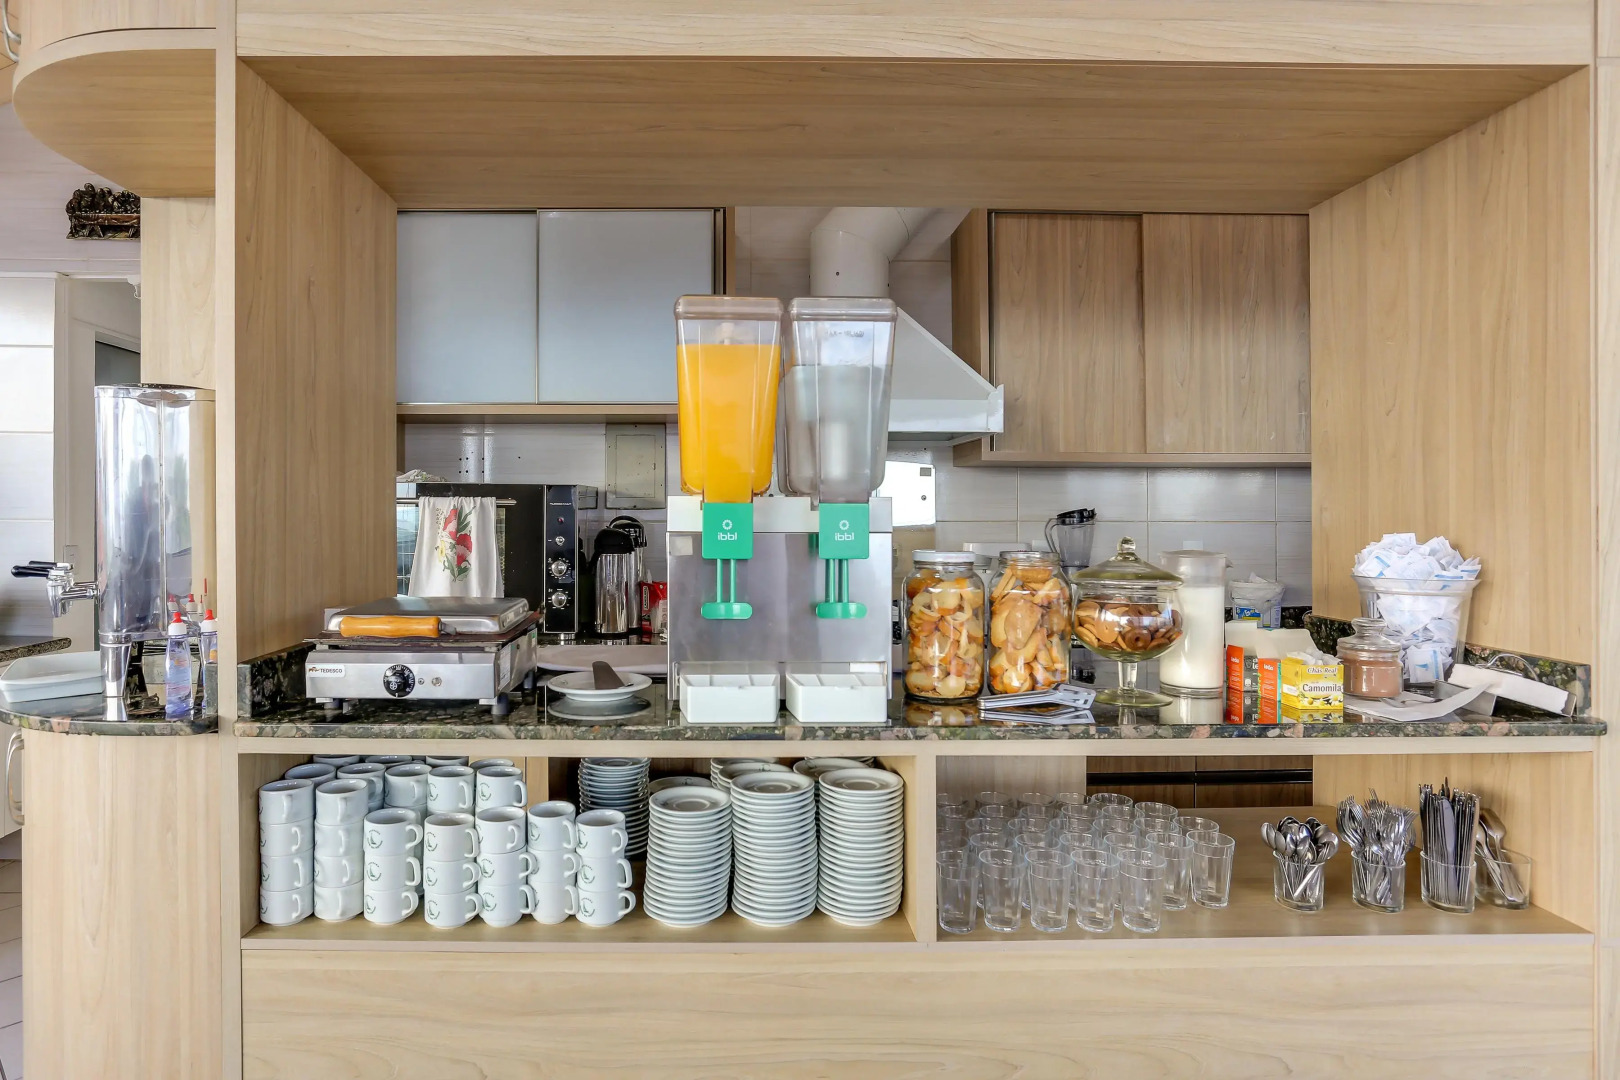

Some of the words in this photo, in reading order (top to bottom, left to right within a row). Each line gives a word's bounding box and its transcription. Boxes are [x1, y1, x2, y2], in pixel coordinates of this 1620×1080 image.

[717, 532, 738, 541] ibbl
[834, 532, 855, 541] ibbl
[1302, 683, 1342, 692] Camomila
